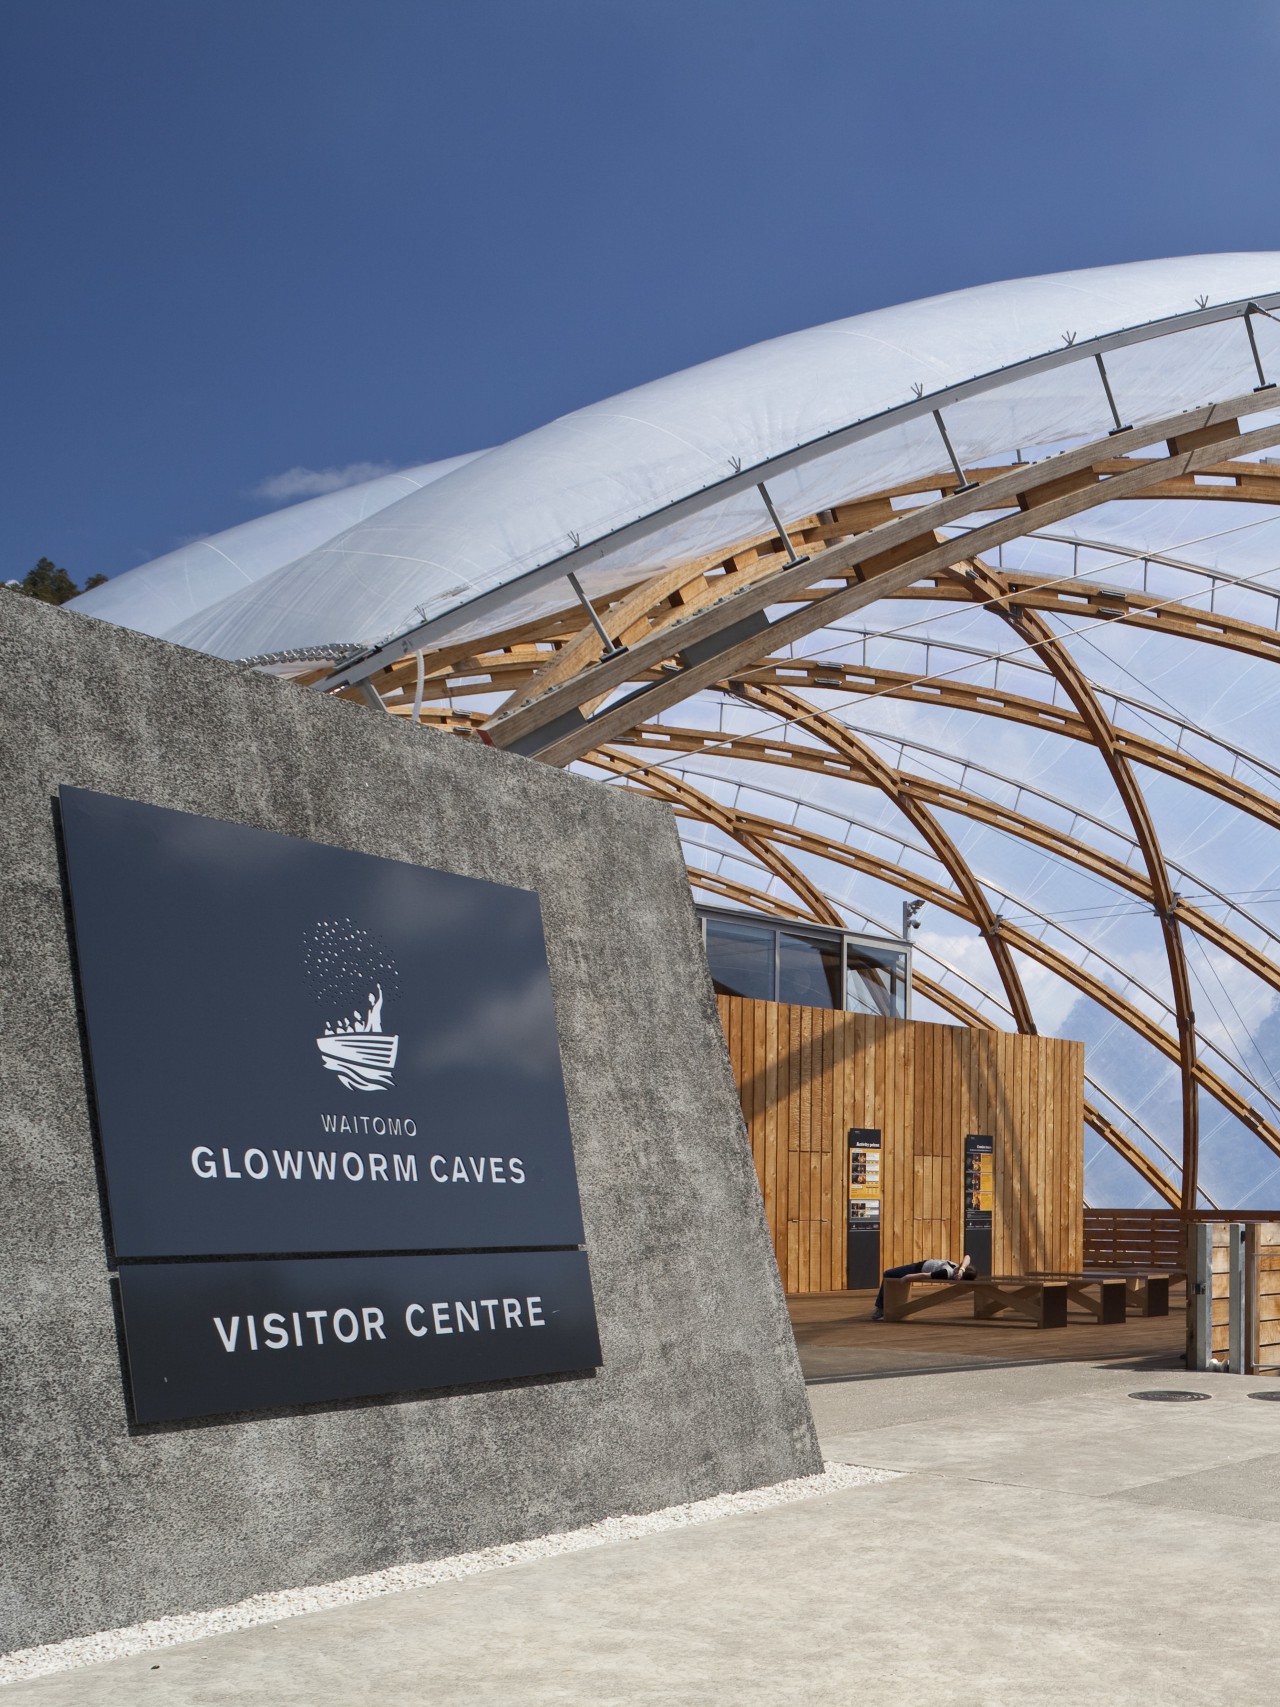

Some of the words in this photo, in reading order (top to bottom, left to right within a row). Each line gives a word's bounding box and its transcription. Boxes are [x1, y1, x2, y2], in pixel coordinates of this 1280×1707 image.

[320, 1114, 417, 1137] WAITOMO
[191, 1146, 418, 1182] GLOWWORM
[429, 1154, 526, 1184] CAVES
[213, 1307, 387, 1353] VISITOR
[405, 1296, 546, 1337] CENTRE
